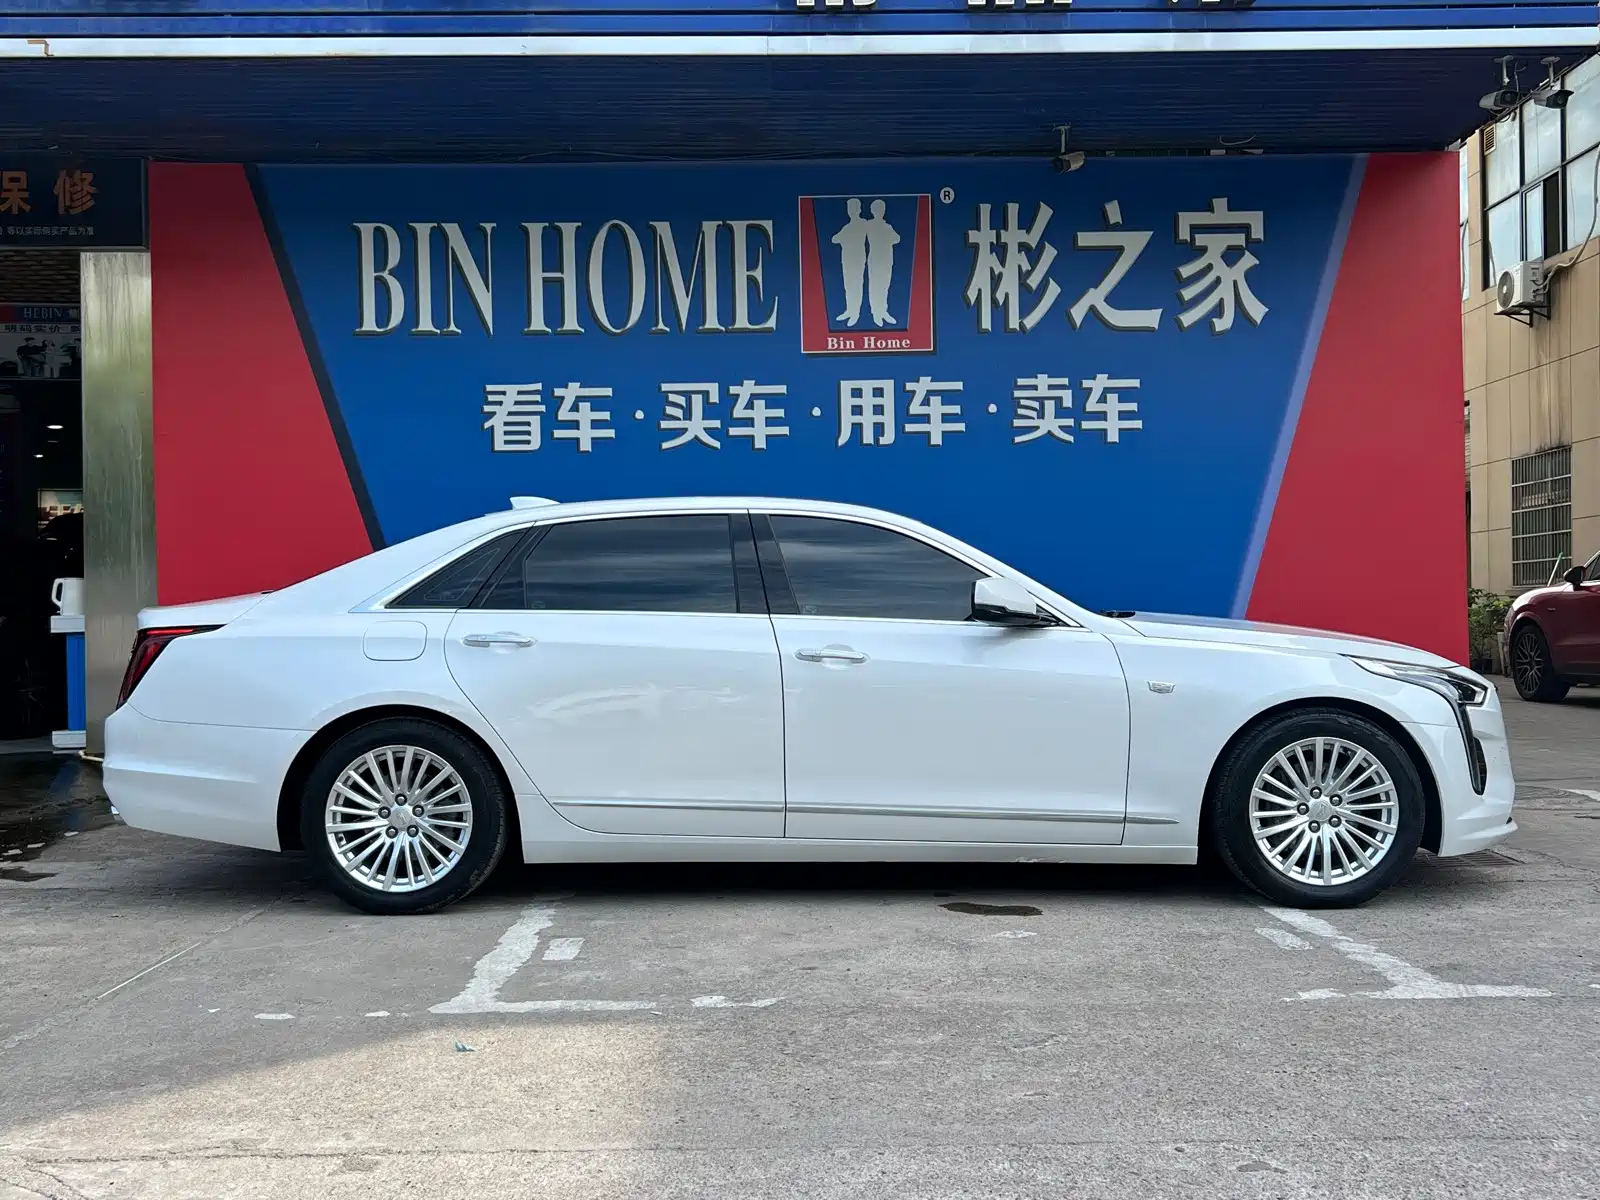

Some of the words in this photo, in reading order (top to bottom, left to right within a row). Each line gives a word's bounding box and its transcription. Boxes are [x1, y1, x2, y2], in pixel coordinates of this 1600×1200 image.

[353, 222, 497, 336] BIN
[520, 218, 779, 335] HOME
[964, 197, 1270, 334] 彬之家
[827, 337, 855, 350] Bin
[863, 336, 911, 349] Home
